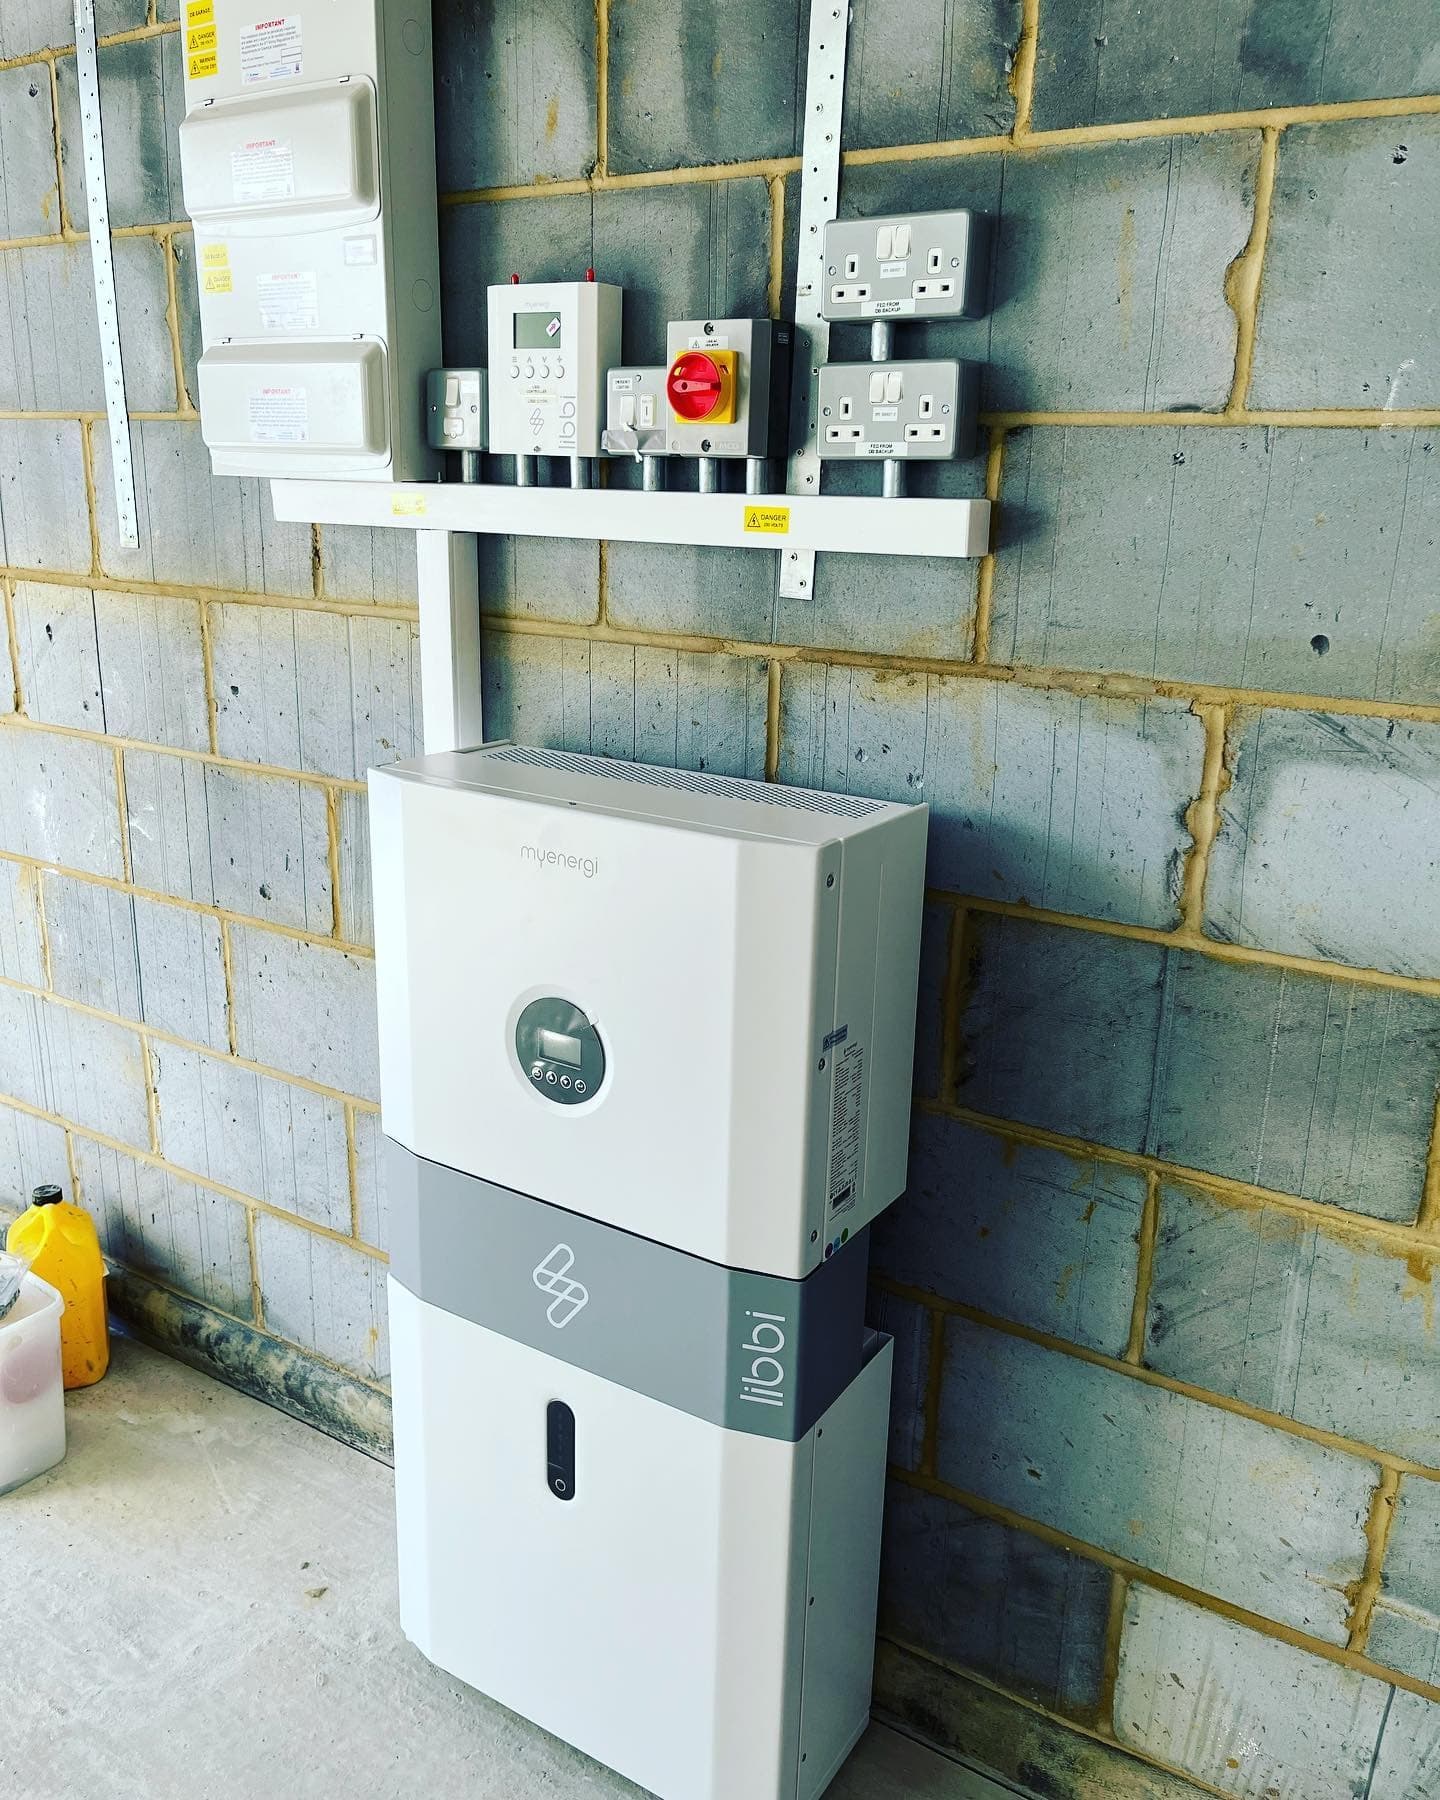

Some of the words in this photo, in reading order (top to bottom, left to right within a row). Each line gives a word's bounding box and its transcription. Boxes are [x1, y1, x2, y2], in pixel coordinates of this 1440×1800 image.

[198, 32, 215, 40] DANGER
[255, 19, 285, 31] IMPORTANT
[246, 140, 276, 149] IMPORTANT
[559, 395, 577, 449] libbi
[520, 845, 599, 879] myenergi
[739, 1310, 786, 1407] libbi
